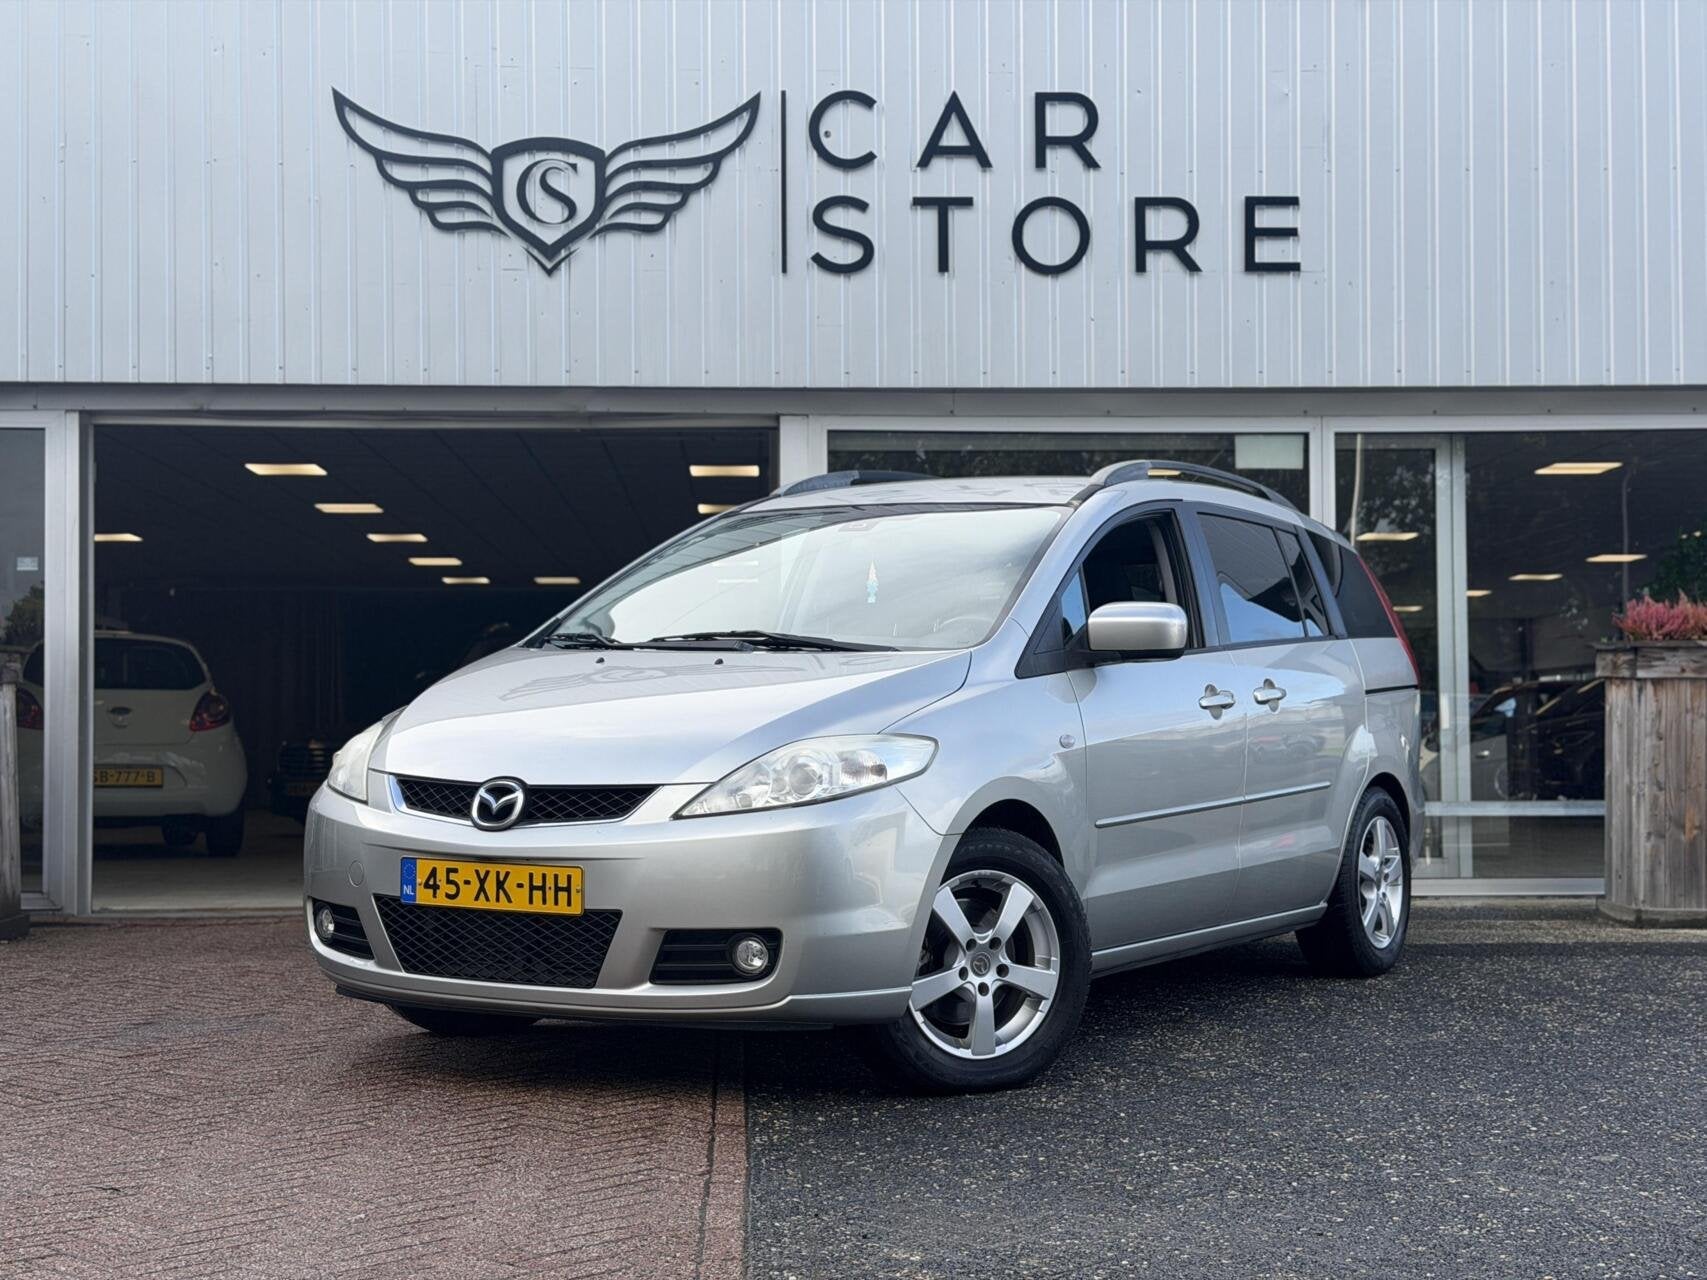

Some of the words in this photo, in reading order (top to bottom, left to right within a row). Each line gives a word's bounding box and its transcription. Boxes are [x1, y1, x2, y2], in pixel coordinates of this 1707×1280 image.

[809, 91, 1101, 170] CAR
[811, 195, 1302, 275] STORE
[403, 885, 415, 896] NL
[423, 866, 572, 907] 45-XK-HH
